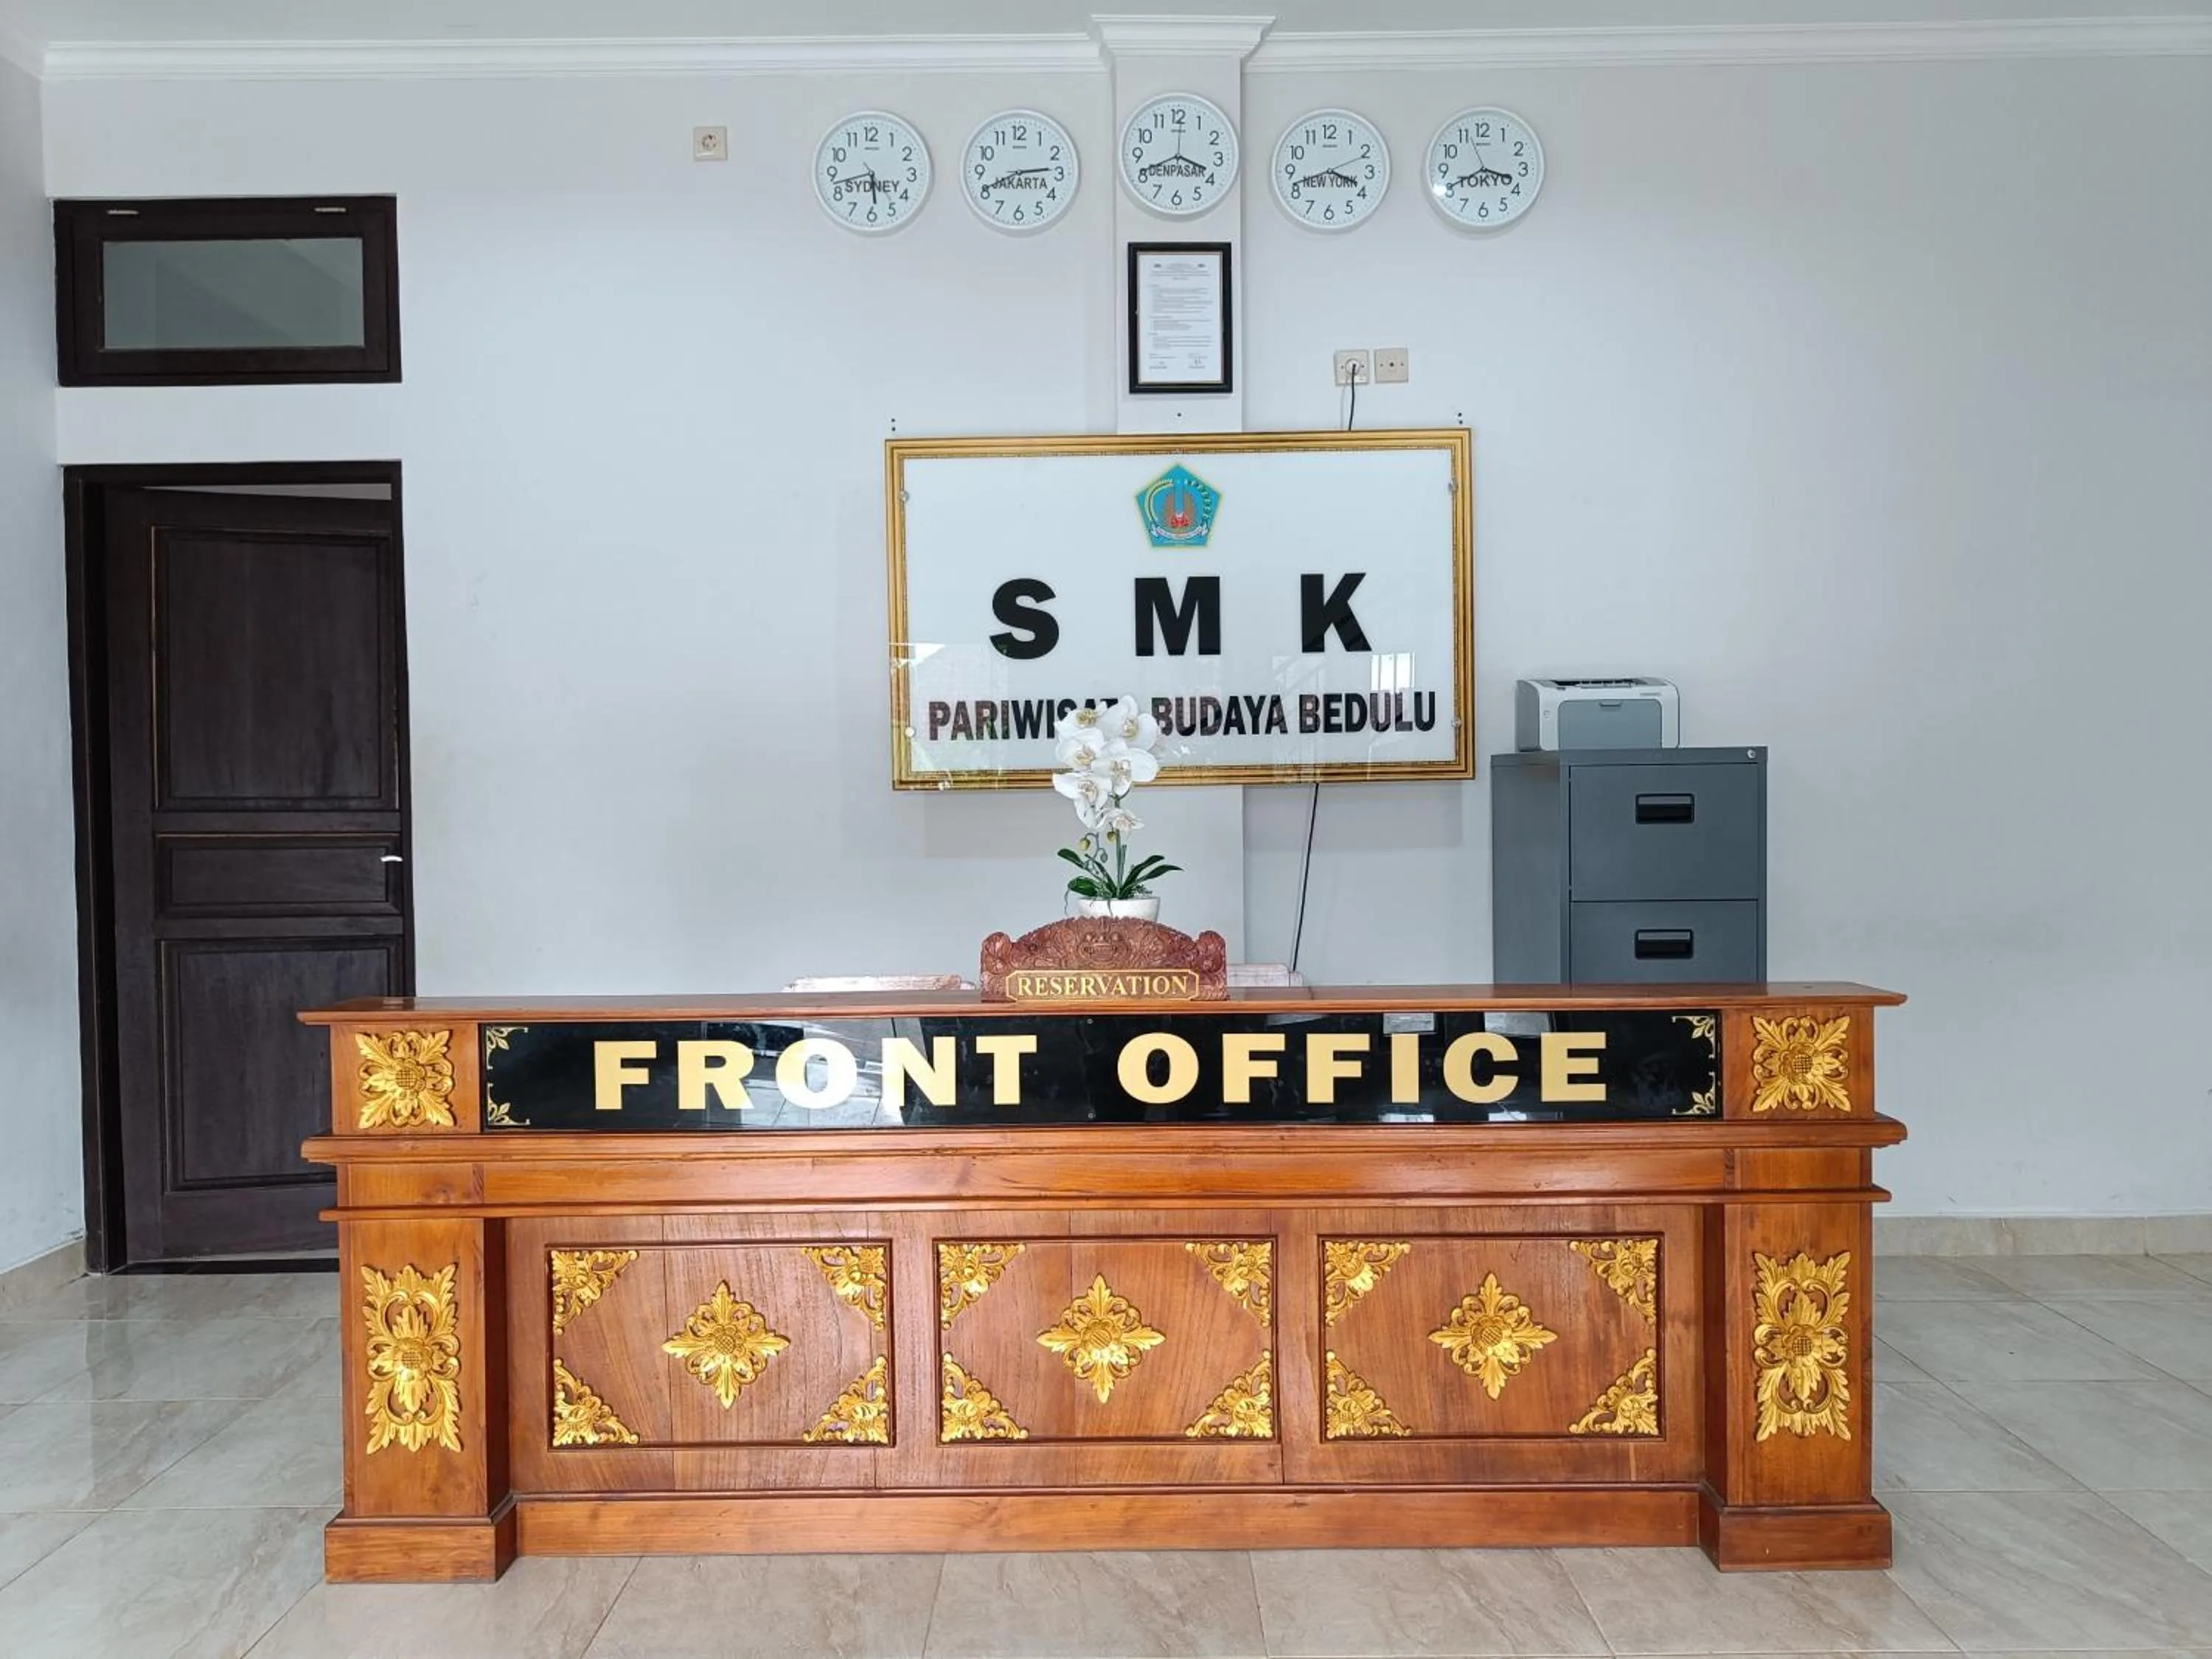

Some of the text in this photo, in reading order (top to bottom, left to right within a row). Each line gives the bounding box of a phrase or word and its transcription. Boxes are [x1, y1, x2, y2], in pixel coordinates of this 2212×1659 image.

[1153, 114, 1164, 129] 11
[1171, 109, 1186, 124] 12
[1196, 116, 1201, 130] 1
[864, 126, 878, 142] 12
[1012, 125, 1026, 140] 12
[1138, 128, 1152, 144] 10
[1305, 130, 1315, 145] 11
[1323, 125, 1337, 139] 12
[1348, 130, 1352, 145] 1
[1458, 128, 1469, 143] 11
[1475, 122, 1490, 138] 12
[1501, 128, 1505, 142] 1
[847, 132, 858, 147] 11
[889, 132, 894, 147] 1
[995, 131, 1005, 145] 11
[1037, 131, 1042, 146] 1
[1209, 131, 1219, 145] 2
[832, 147, 846, 162] 10
[902, 147, 912, 161] 2
[980, 146, 994, 161] 10
[1050, 145, 1060, 161] 2
[1133, 147, 1143, 163] 9
[1290, 145, 1304, 160] 10
[1360, 145, 1370, 158] 2
[1444, 144, 1458, 159] 10
[1514, 142, 1524, 156] 2
[1213, 151, 1223, 167] 3
[827, 166, 838, 181] 9
[906, 167, 917, 182] 3
[974, 164, 985, 180] 9
[1054, 166, 1064, 181] 3
[1138, 168, 1147, 183] 8
[1149, 164, 1205, 177] DENPASAR
[1285, 164, 1295, 180] 9
[1364, 164, 1374, 179] 3
[1439, 164, 1449, 178] 9
[1518, 162, 1528, 177] 3
[845, 180, 900, 192] SYDNEY
[993, 177, 1048, 189] JAKARTA
[1205, 173, 1214, 185] 4
[1304, 175, 1357, 187] NEW YORK
[1458, 175, 1512, 187] TOKYO
[833, 186, 843, 201] 8
[900, 189, 908, 202] 4
[981, 184, 990, 200] 8
[1046, 187, 1056, 201] 4
[1152, 184, 1162, 198] 7
[1192, 187, 1201, 201] 5
[1291, 184, 1301, 199] 8
[1357, 187, 1366, 199] 4
[1445, 183, 1454, 198] 8
[1512, 184, 1520, 195] 4
[1171, 190, 1181, 206] 6
[1460, 198, 1469, 212] 7
[1499, 198, 1507, 212] 5
[849, 202, 858, 217] 7
[867, 206, 877, 222] 6
[888, 202, 896, 217] 5
[995, 201, 1004, 214] 7
[1014, 205, 1024, 221] 6
[1034, 201, 1043, 215] 5
[1305, 201, 1315, 215] 7
[1324, 204, 1334, 220] 6
[1345, 201, 1353, 214] 5
[1478, 202, 1488, 218] 6
[928, 691, 1436, 740] PARIWI BUDAYA BEDULU
[1018, 975, 1187, 995] RESERVATION
[594, 1032, 1607, 1110] FRONT OFFICE
